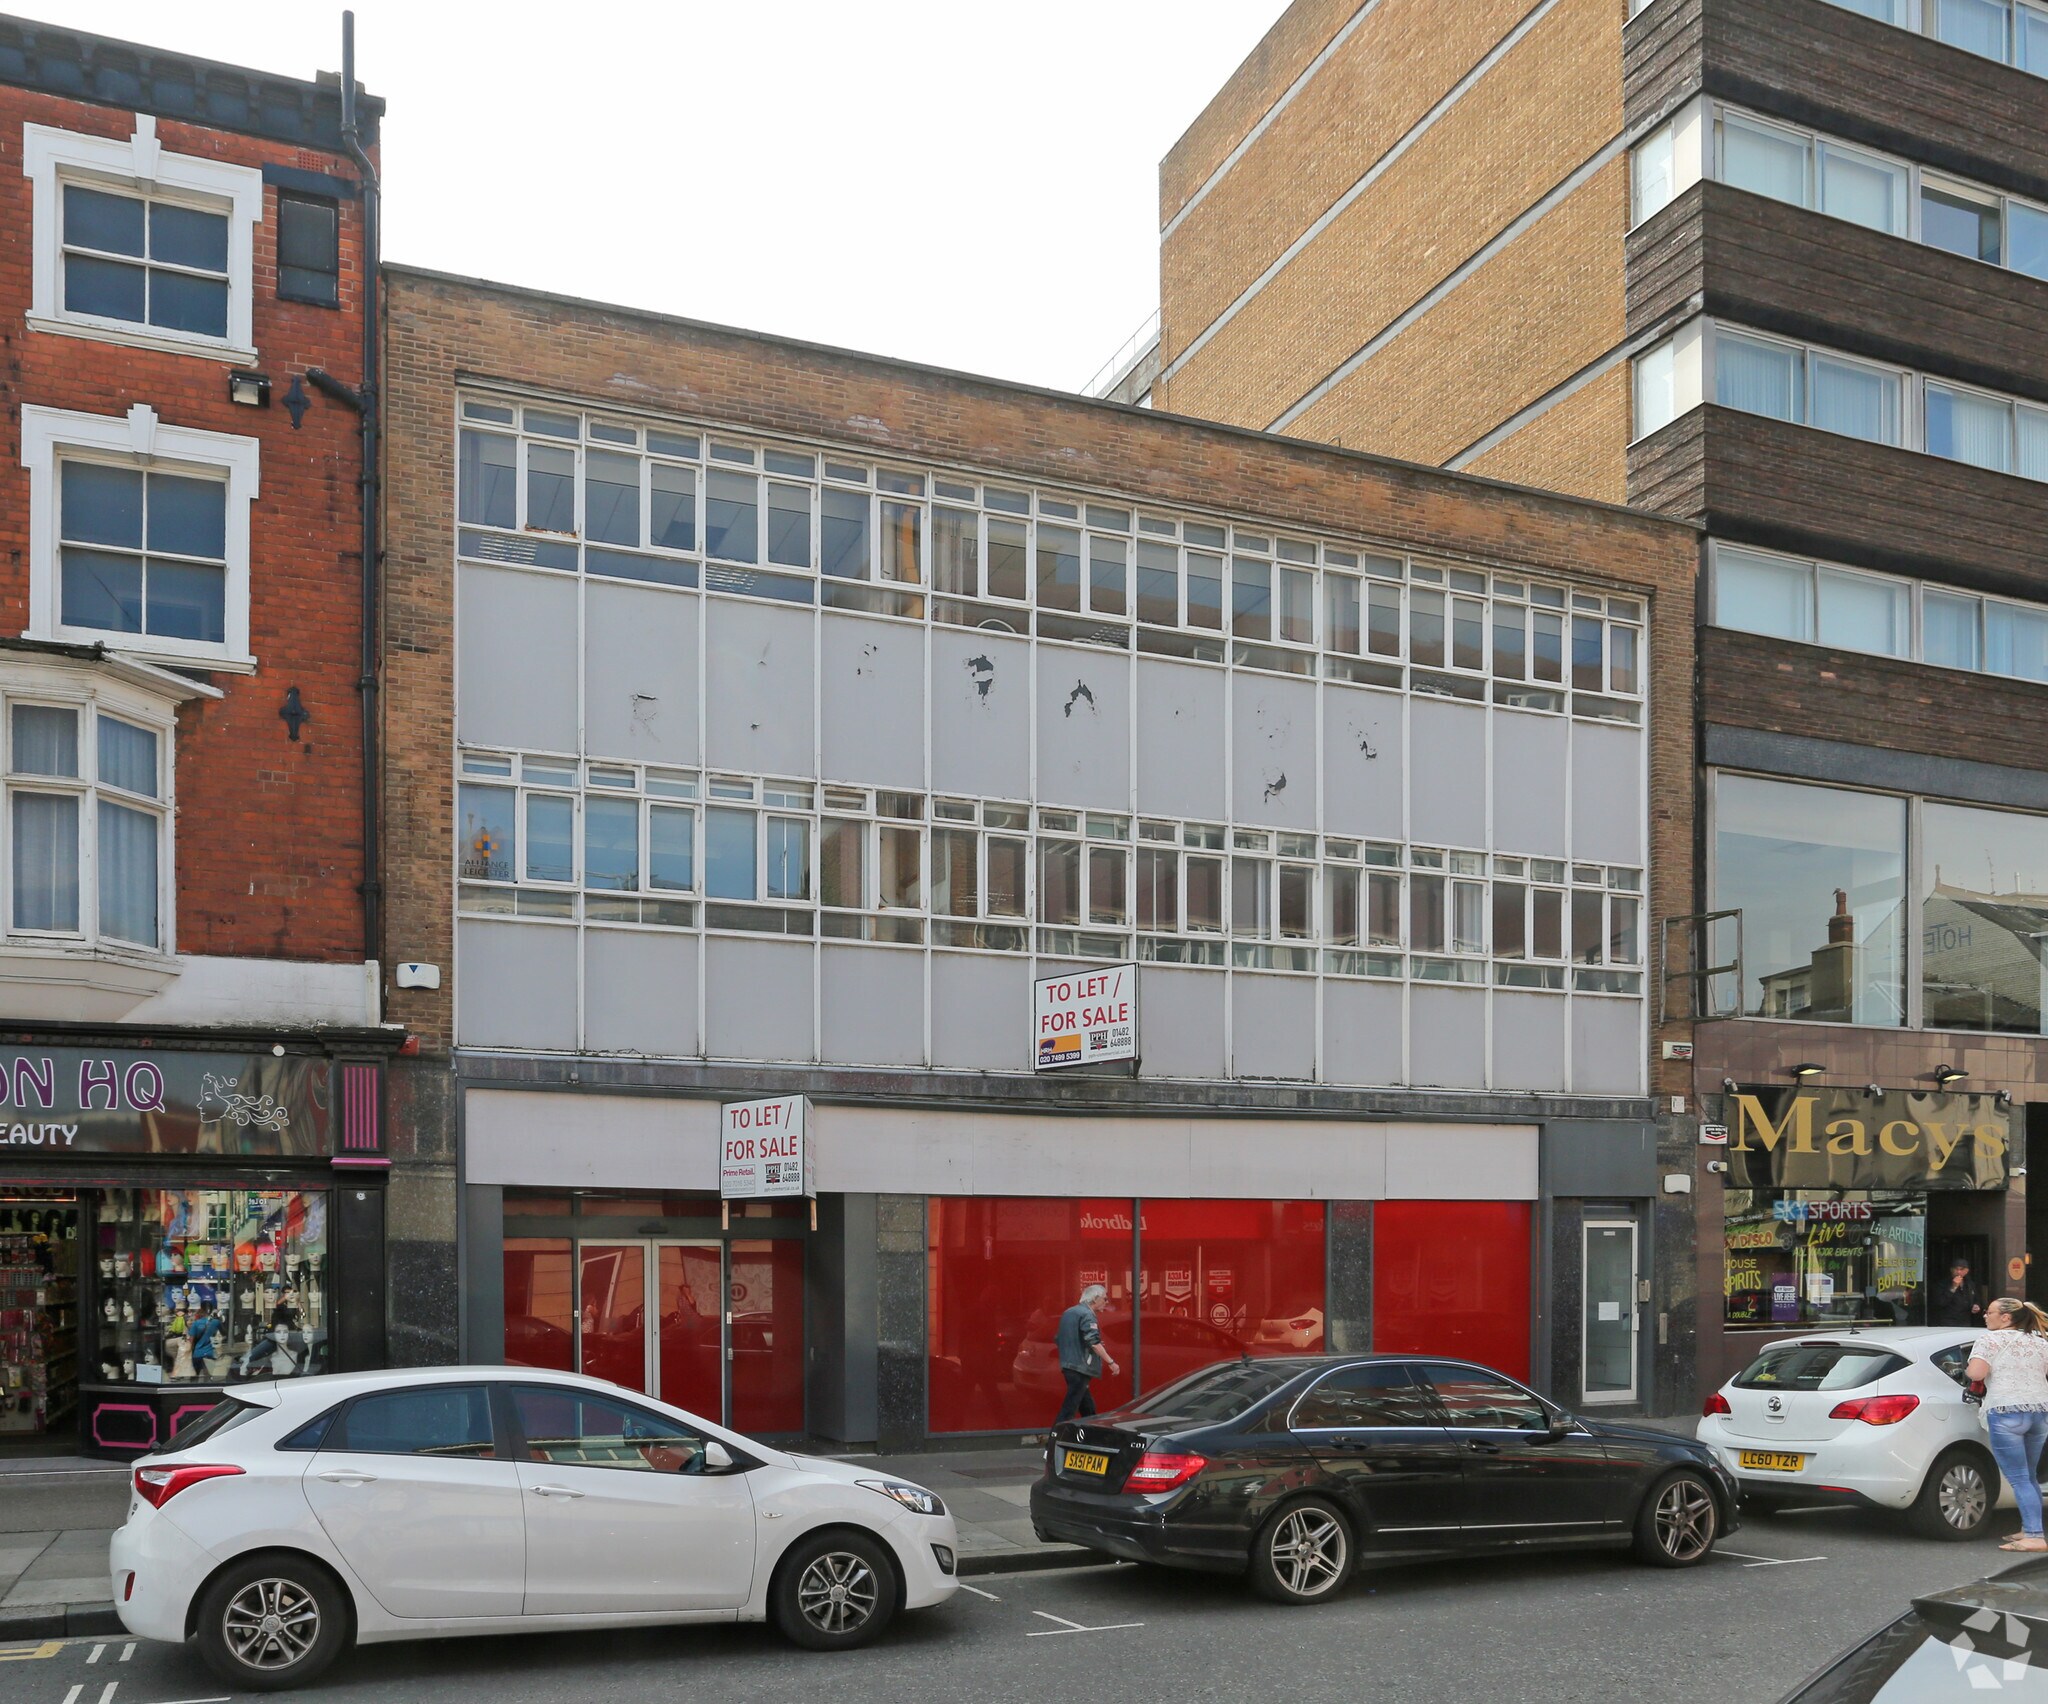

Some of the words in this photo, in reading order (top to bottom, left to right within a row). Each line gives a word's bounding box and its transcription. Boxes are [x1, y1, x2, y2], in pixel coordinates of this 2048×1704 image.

[464, 859, 509, 869] ALLIANCE
[464, 867, 510, 878] LEICESTER
[1046, 982, 1071, 1003] TO
[1077, 975, 1109, 999] LET
[1041, 1011, 1076, 1033] FOR
[1082, 1002, 1128, 1027] SALE
[1091, 1032, 1106, 1041] PPH
[1111, 1026, 1130, 1038] 01482
[1109, 1036, 1132, 1048] 648888
[1039, 1055, 1051, 1063] 020
[1051, 1054, 1065, 1062] 7499
[79, 1059, 166, 1114] HQ
[730, 1108, 750, 1129] TO
[755, 1104, 782, 1127] LET
[1729, 1093, 2005, 1171] Macys
[726, 1139, 755, 1160] FOR
[759, 1135, 798, 1159] SALE
[722, 1168, 738, 1177] Prime
[766, 1165, 780, 1174] PPH
[783, 1161, 798, 1172] 01482
[1773, 1200, 1808, 1220] SKY
[1808, 1201, 1872, 1220] SPORTS
[1807, 1221, 1846, 1247] Live
[1888, 1225, 1923, 1248] ARTISTS
[1834, 1246, 1864, 1257] EVENTS
[1723, 1258, 1757, 1269] HOUSE
[1723, 1270, 1762, 1296] SPIRITS
[1877, 1270, 1917, 1293] BOTTLES
[1742, 1452, 1772, 1466] LC60
[1775, 1454, 1799, 1468] TZR
